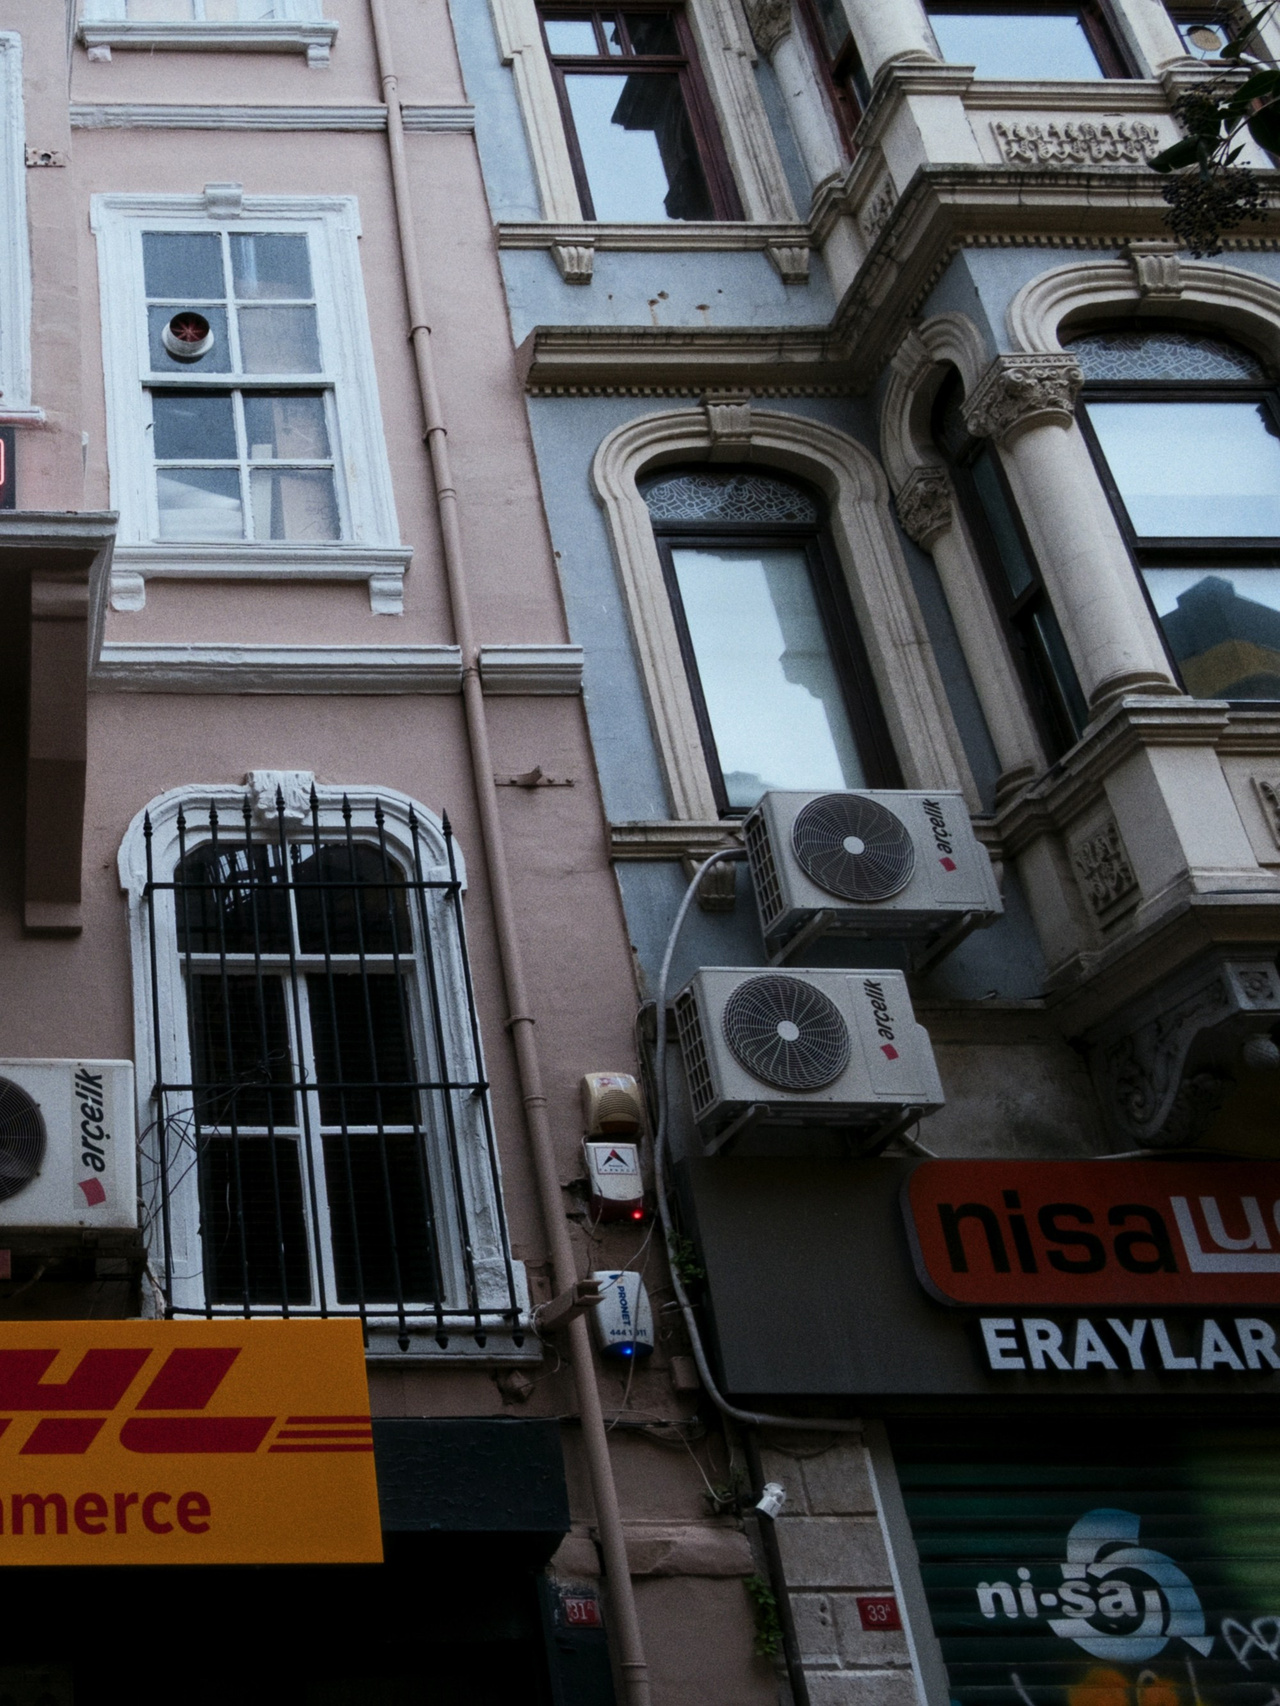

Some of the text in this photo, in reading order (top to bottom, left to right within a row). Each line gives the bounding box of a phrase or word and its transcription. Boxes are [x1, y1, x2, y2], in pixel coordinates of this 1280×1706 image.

[923, 797, 952, 854] arçelik
[863, 978, 895, 1041] arçelik
[74, 1068, 110, 1172] arçelik
[617, 1285, 631, 1326] PRONET
[979, 1318, 1280, 1370] ERAYLAR
[975, 1567, 1139, 1619] ni-sa
